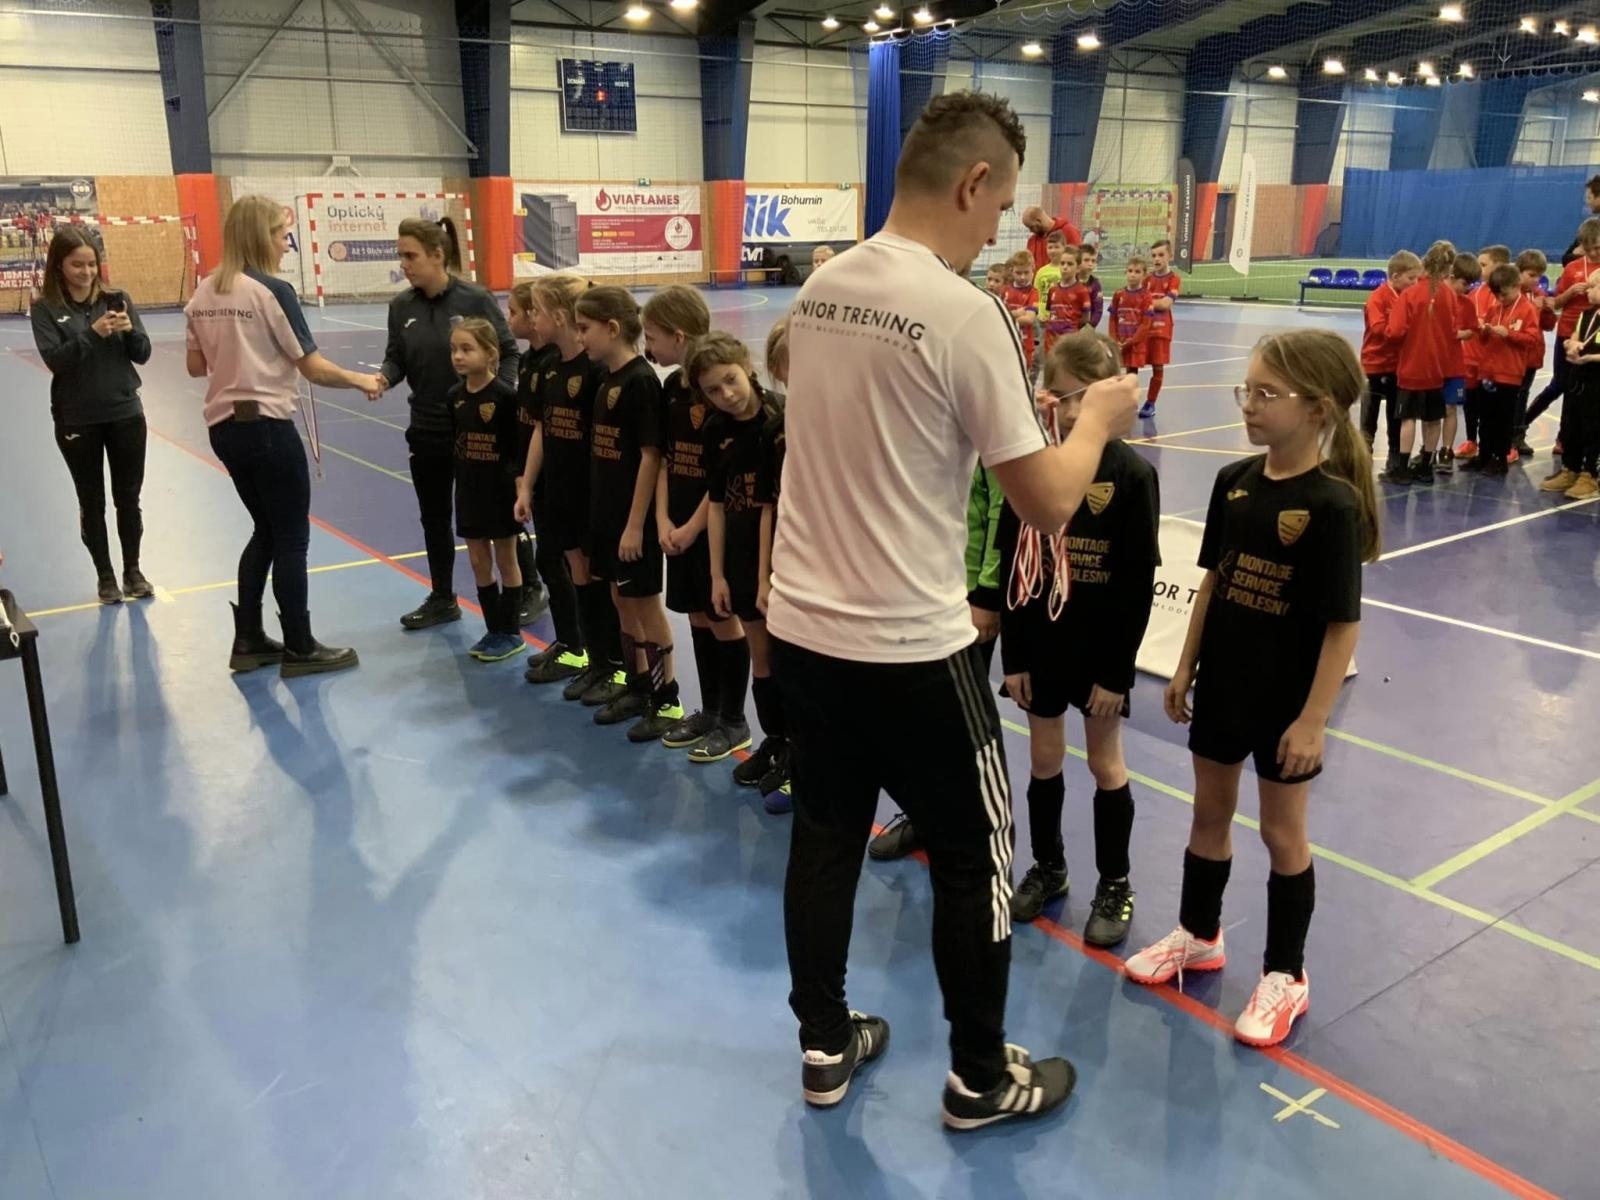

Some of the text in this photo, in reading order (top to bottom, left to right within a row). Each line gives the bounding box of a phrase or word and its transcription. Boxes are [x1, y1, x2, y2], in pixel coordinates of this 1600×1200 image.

[612, 194, 680, 206] VIAFLAMES
[328, 219, 388, 233] internet
[842, 306, 925, 340] TRENING
[1237, 553, 1294, 580] MONTAGE
[1232, 570, 1284, 597] SERVICE
[1226, 587, 1291, 617] PODLESNY
